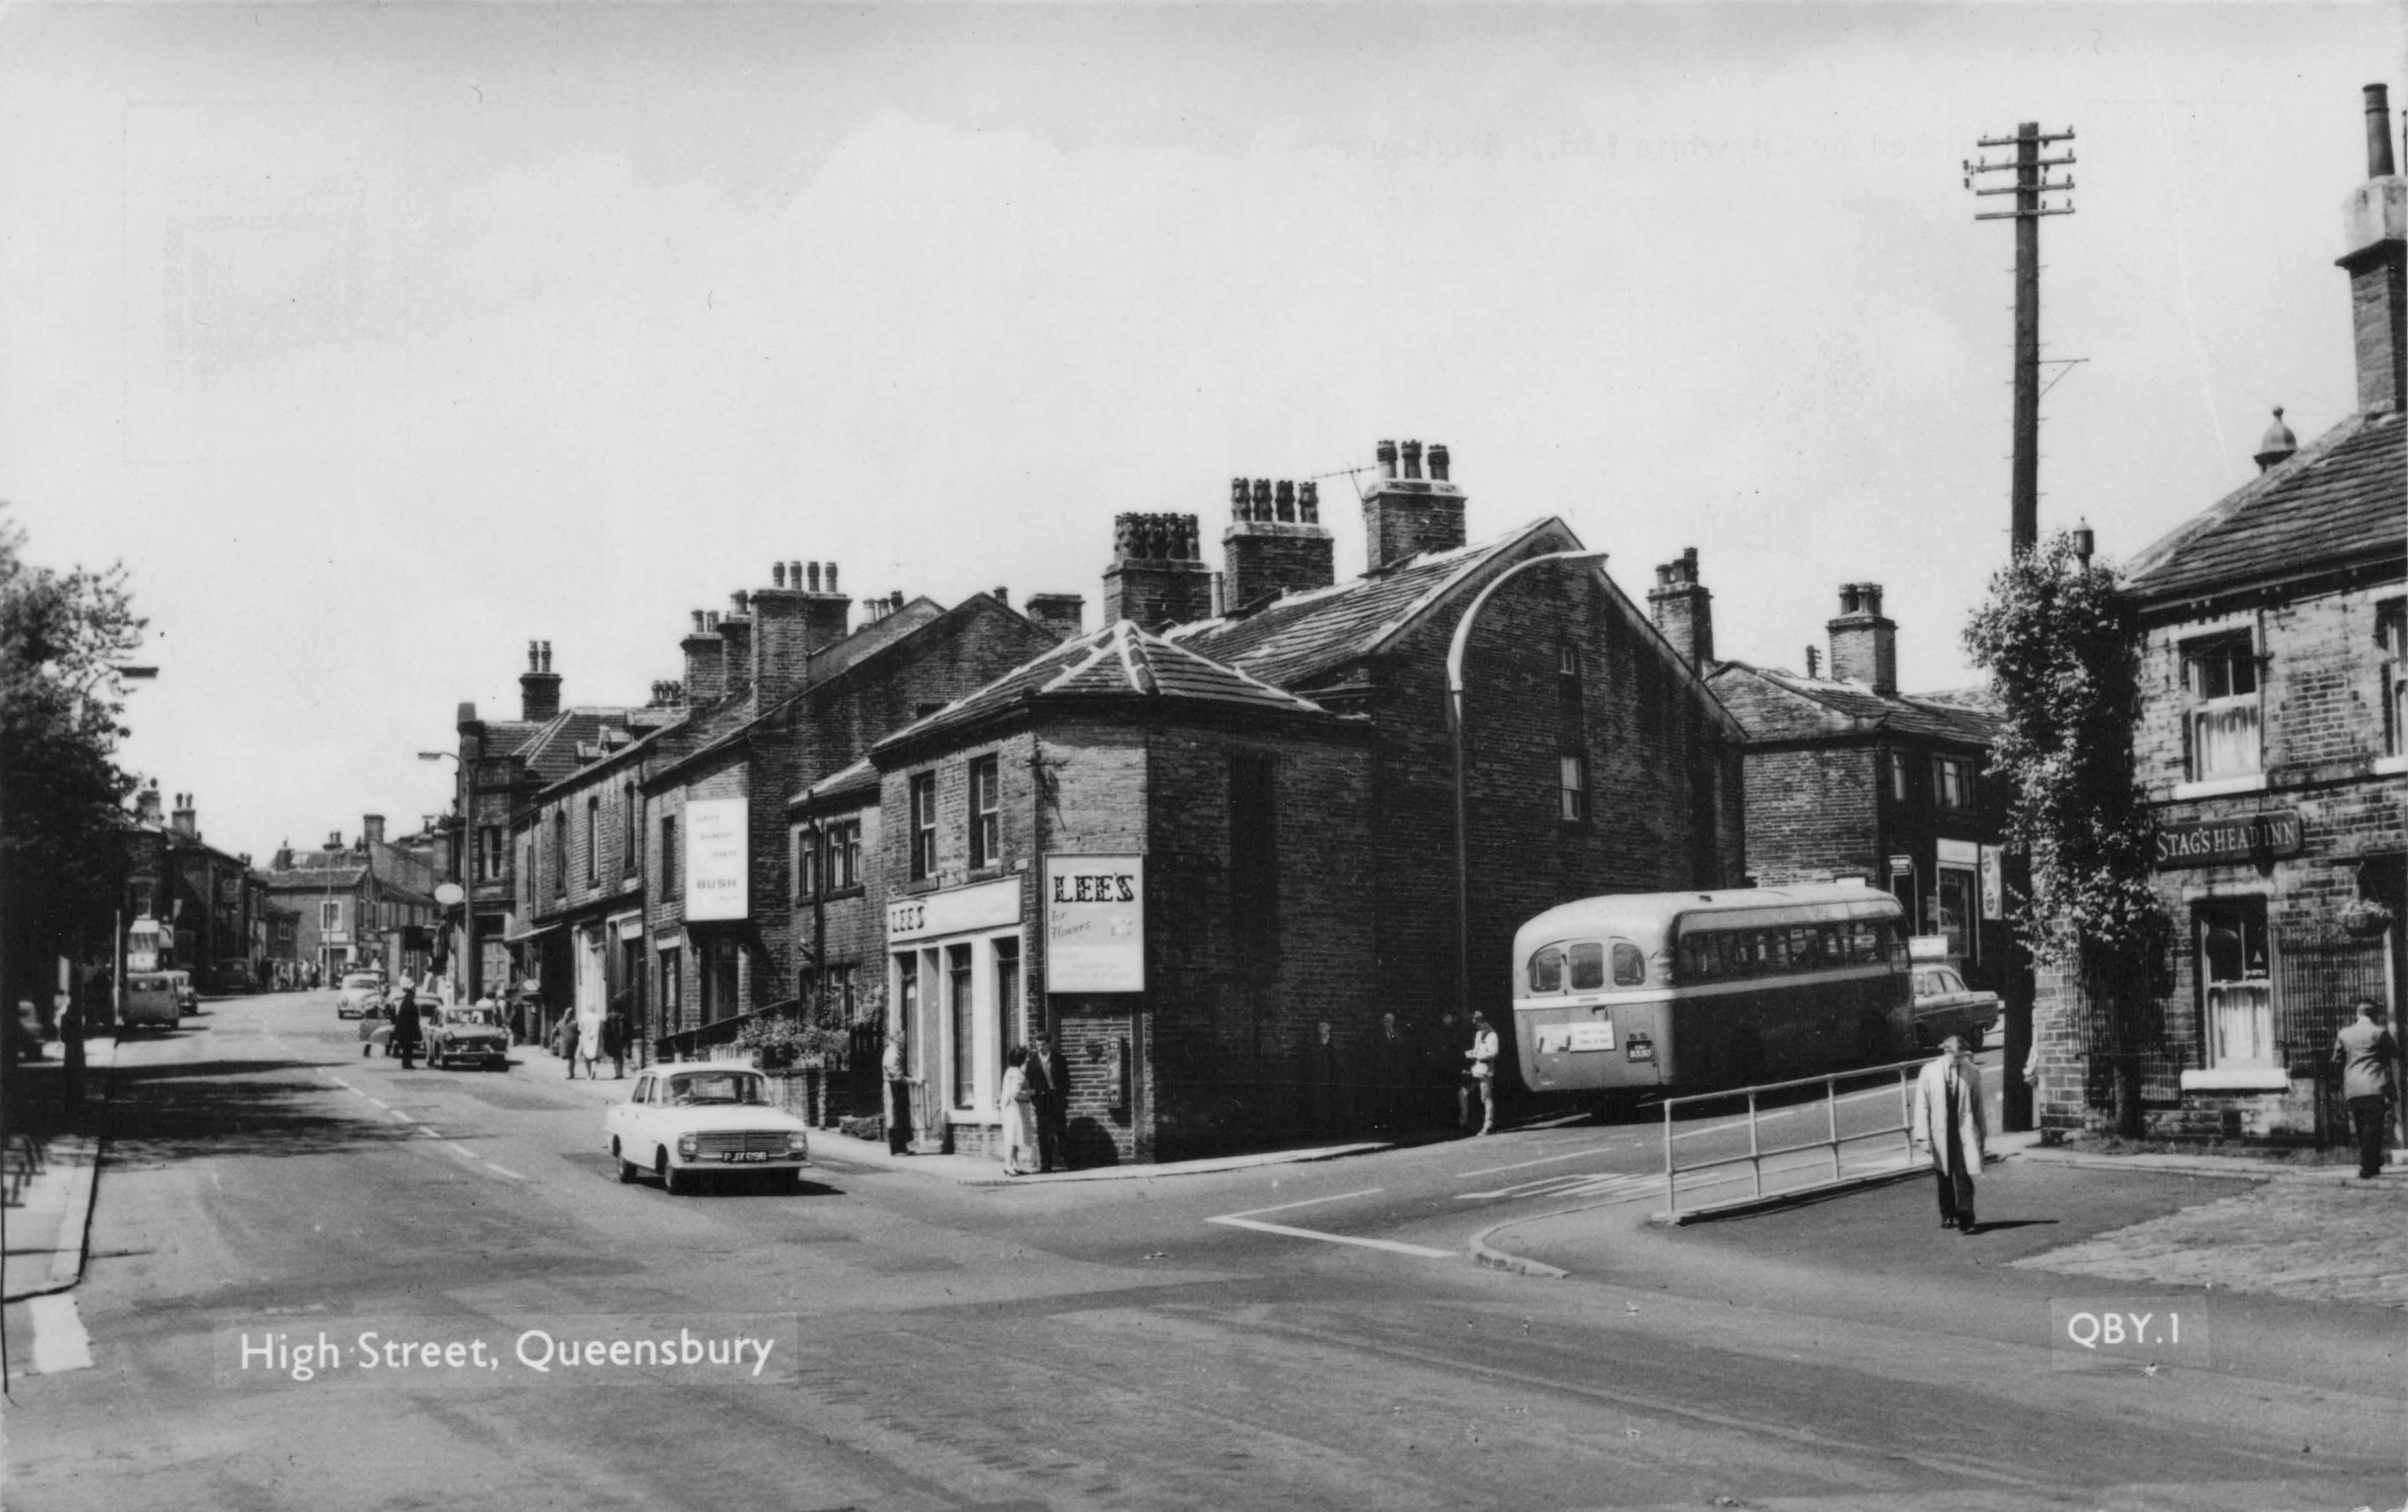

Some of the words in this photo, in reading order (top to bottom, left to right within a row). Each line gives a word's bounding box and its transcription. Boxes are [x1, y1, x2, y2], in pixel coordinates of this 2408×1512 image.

[2214, 825, 2259, 852] HEAD
[2264, 821, 2295, 846] INN
[697, 879, 737, 890] BUSH
[1053, 872, 1134, 903] LEE'S
